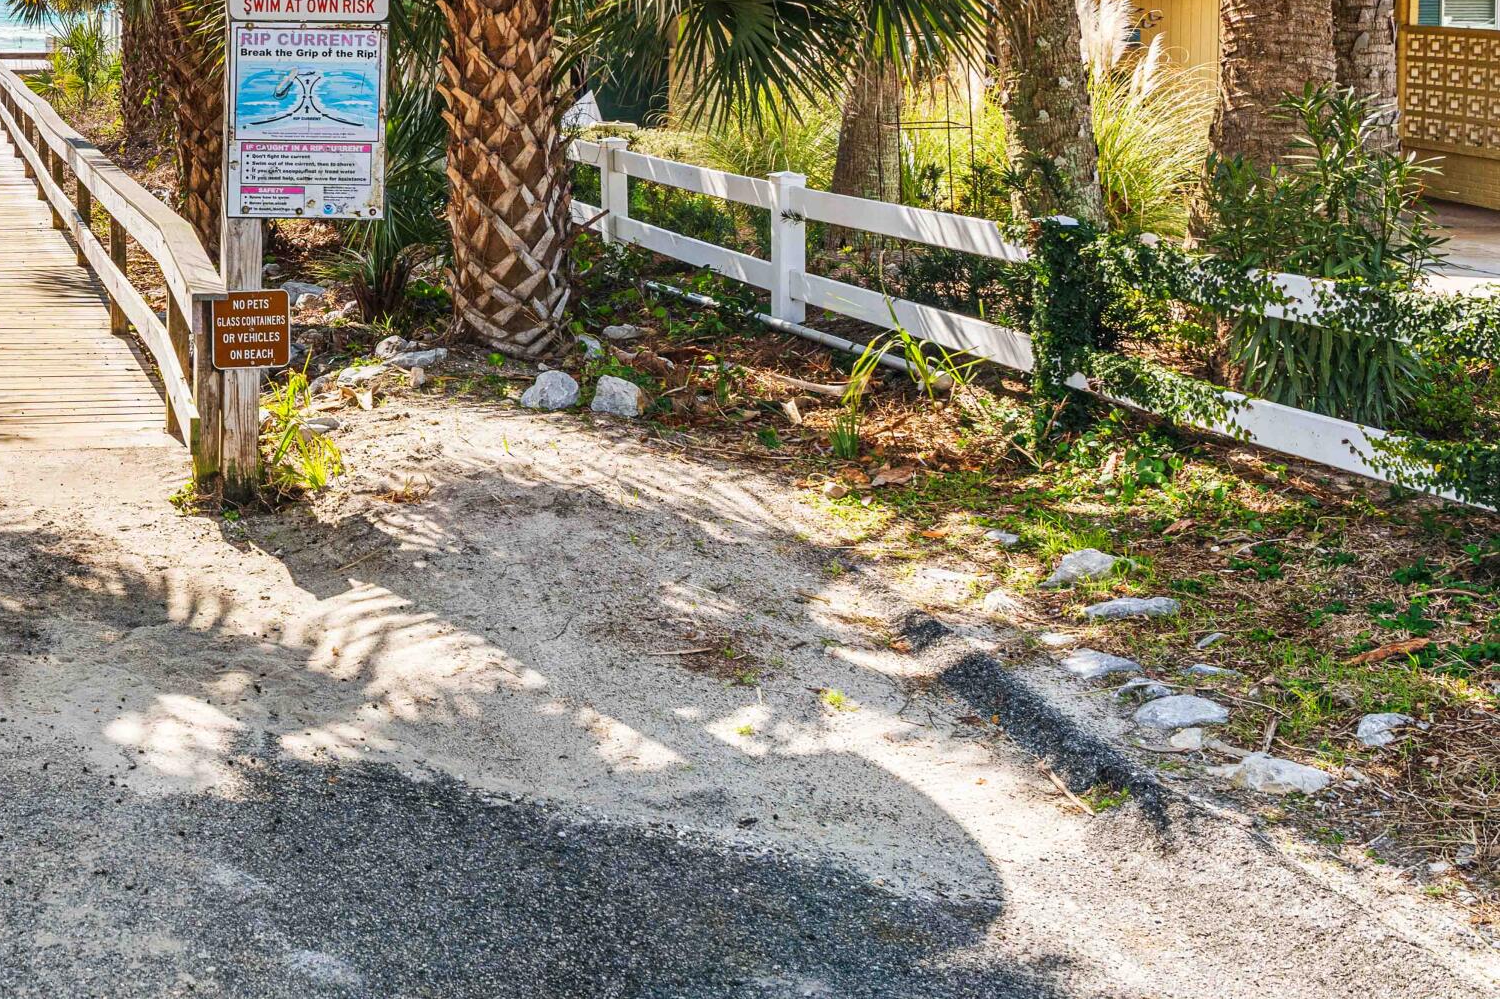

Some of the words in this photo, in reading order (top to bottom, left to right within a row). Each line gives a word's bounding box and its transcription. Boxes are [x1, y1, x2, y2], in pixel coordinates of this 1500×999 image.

[286, 0, 302, 12] AT
[307, 0, 338, 13] OWN
[343, 0, 375, 13] RISK
[241, 33, 271, 46] RIP
[278, 33, 377, 46] CURRENTS
[241, 48, 272, 56] Break
[276, 49, 292, 57] the
[296, 49, 318, 58] Grip
[322, 48, 333, 58] of
[336, 50, 353, 58] the
[357, 50, 377, 59] Rip!
[233, 300, 245, 310] NO
[247, 299, 269, 309] PETS
[217, 317, 240, 327] GLASS
[242, 315, 285, 325] CONTAINERS
[223, 334, 235, 343] OR
[238, 332, 280, 343] VEHICLES
[230, 350, 242, 359] ON
[244, 349, 273, 359] BEACH
